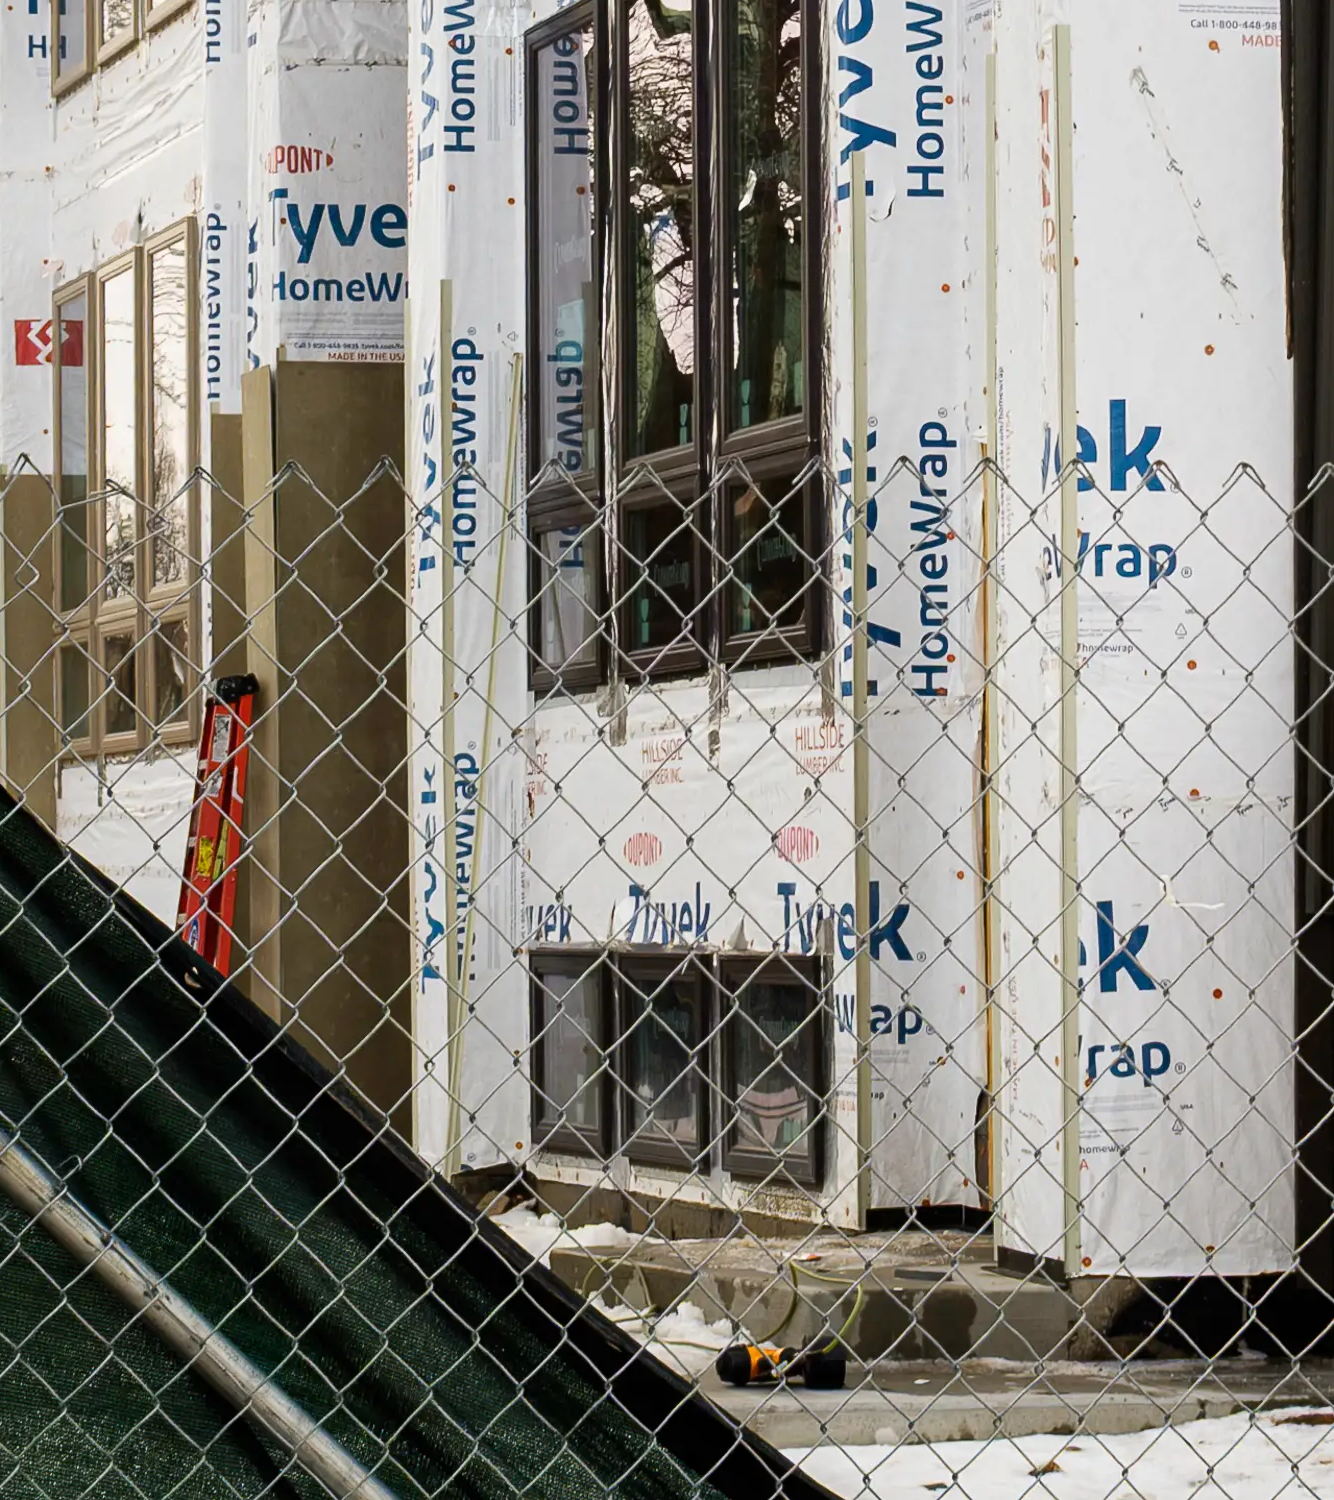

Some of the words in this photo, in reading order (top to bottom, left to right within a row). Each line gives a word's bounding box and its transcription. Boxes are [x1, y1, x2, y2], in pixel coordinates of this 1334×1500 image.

[1191, 19, 1209, 28] Call
[328, 352, 355, 361] MADE
[357, 352, 367, 361] IN
[369, 352, 387, 361] THE
[910, 421, 957, 697] HomeWrap
[641, 738, 683, 765] HILLSIDE
[795, 724, 845, 752] HILLSIDE
[795, 758, 827, 776] LUMBER
[627, 833, 659, 866] DUPONT
[777, 827, 814, 862] DUPONT
